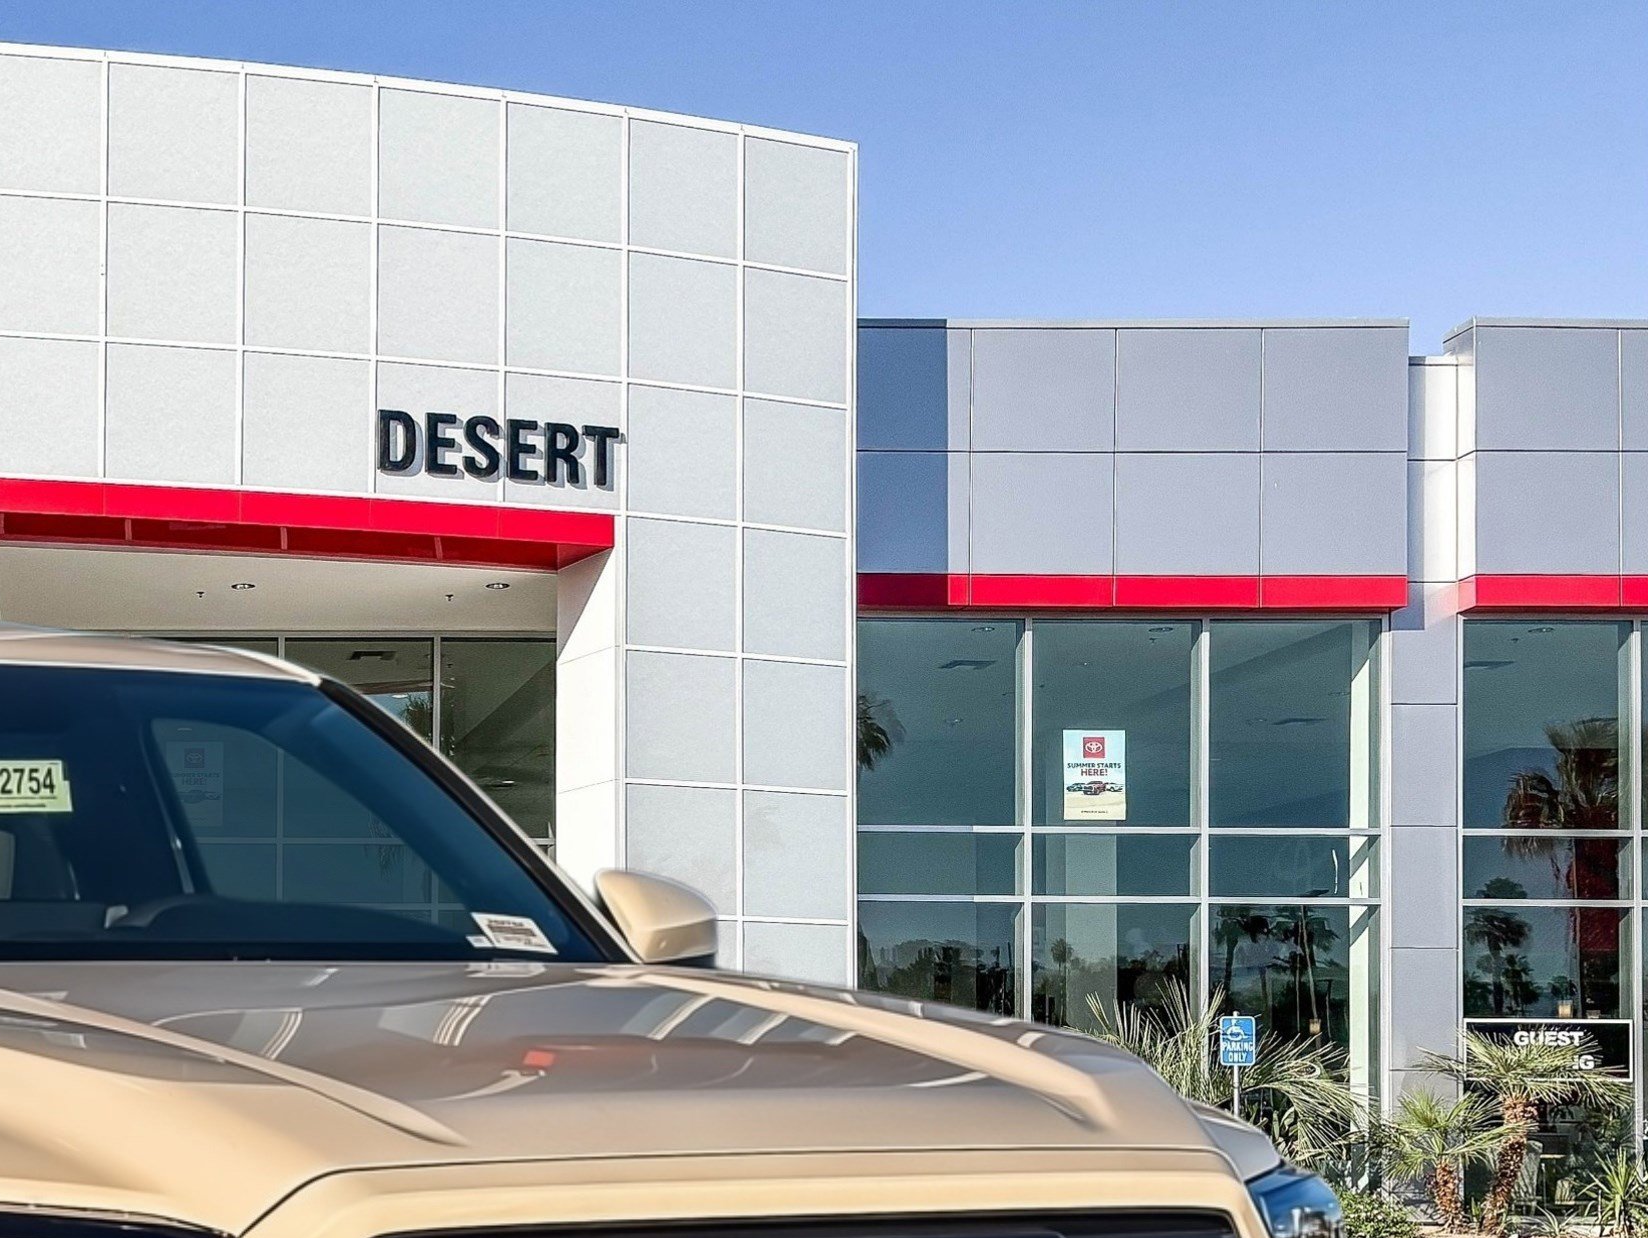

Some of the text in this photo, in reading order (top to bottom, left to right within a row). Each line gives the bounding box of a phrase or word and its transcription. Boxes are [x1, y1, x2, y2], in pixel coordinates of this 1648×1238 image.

[377, 409, 620, 487] DESERT
[1513, 1030, 1583, 1047] GUEST
[1221, 1041, 1253, 1051] PARKING
[1228, 1052, 1247, 1062] ONLY
